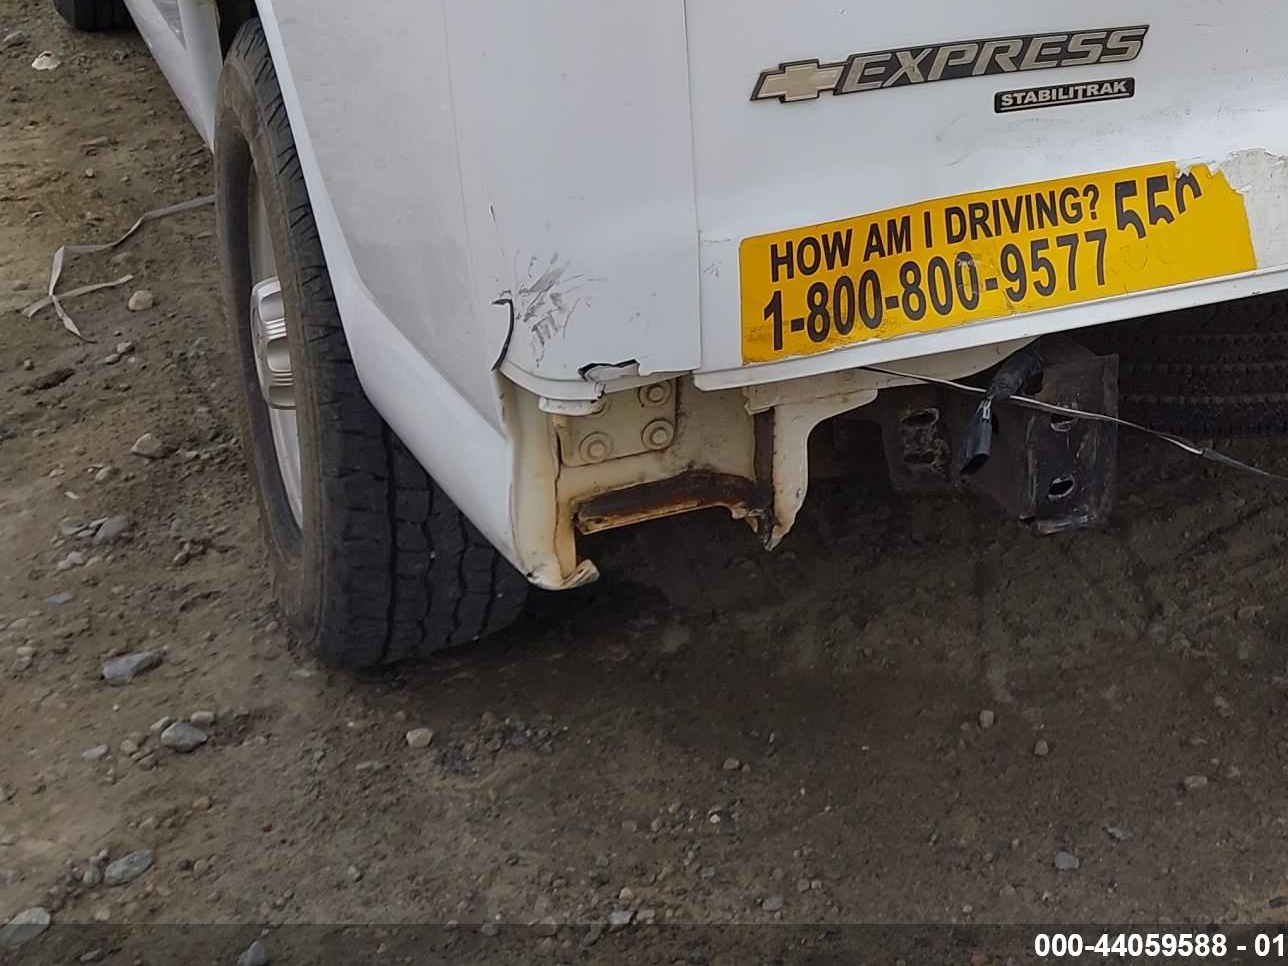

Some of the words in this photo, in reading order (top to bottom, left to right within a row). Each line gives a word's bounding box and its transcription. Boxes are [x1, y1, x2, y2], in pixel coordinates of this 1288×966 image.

[842, 28, 1147, 94] EXPRESS
[1000, 79, 1129, 108] STABILITRAK
[770, 229, 853, 283] HOW
[863, 216, 912, 259] AM
[924, 212, 933, 249] I
[946, 183, 1100, 244] DRIVING?
[762, 228, 1109, 351] 1-800-800-9577
